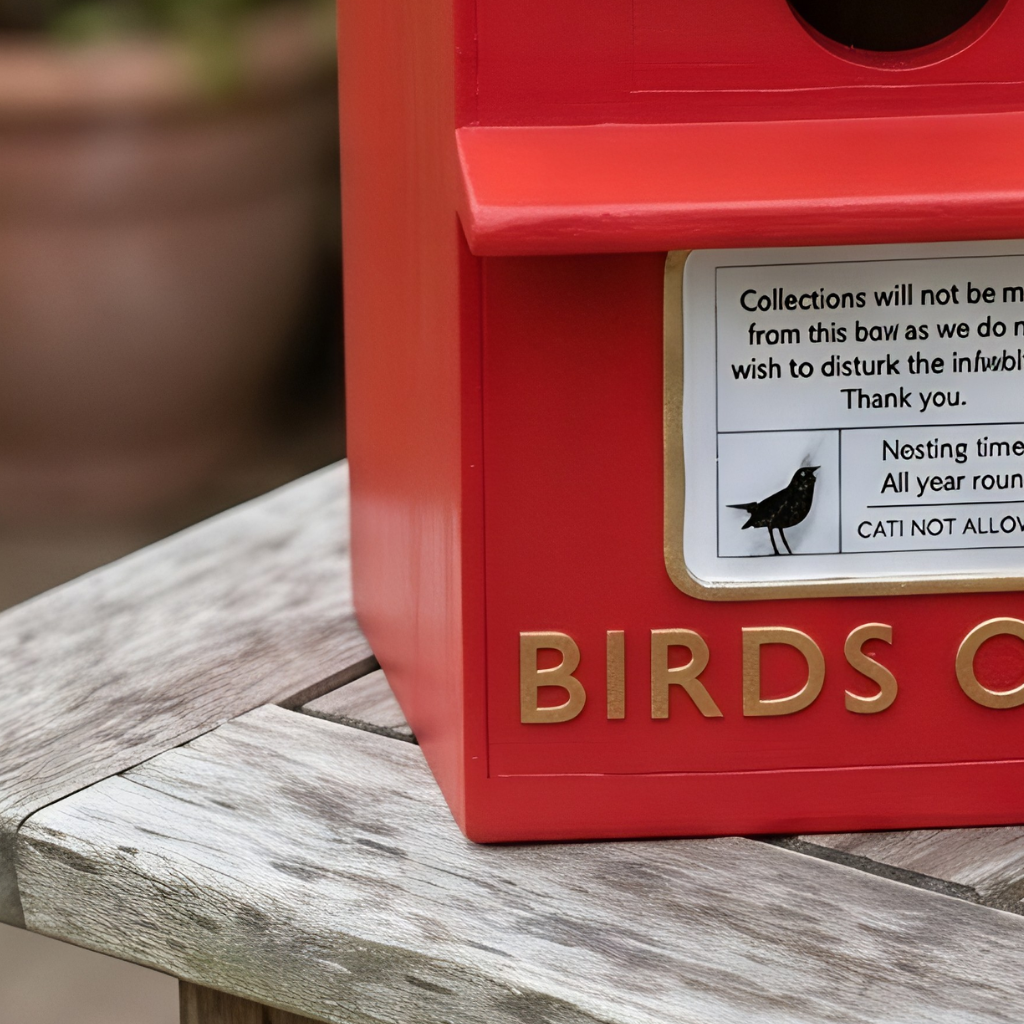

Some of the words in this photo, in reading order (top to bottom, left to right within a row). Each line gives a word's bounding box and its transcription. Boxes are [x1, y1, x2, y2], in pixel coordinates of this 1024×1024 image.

[739, 285, 867, 313] Collections
[873, 282, 914, 307] will
[920, 283, 960, 306] not
[966, 280, 997, 305] be
[747, 321, 801, 346] from
[807, 321, 848, 344] this
[904, 323, 930, 341] as
[936, 322, 971, 339] we
[976, 314, 1007, 338] do
[730, 356, 782, 380] wish
[788, 358, 815, 379] to
[820, 353, 901, 378] disturk
[907, 350, 945, 375] the
[839, 386, 913, 410] Thank
[918, 390, 967, 414] you.
[880, 471, 909, 494] All
[916, 475, 966, 498] year
[911, 517, 957, 537] NOT
[519, 622, 898, 723] BIRDS
